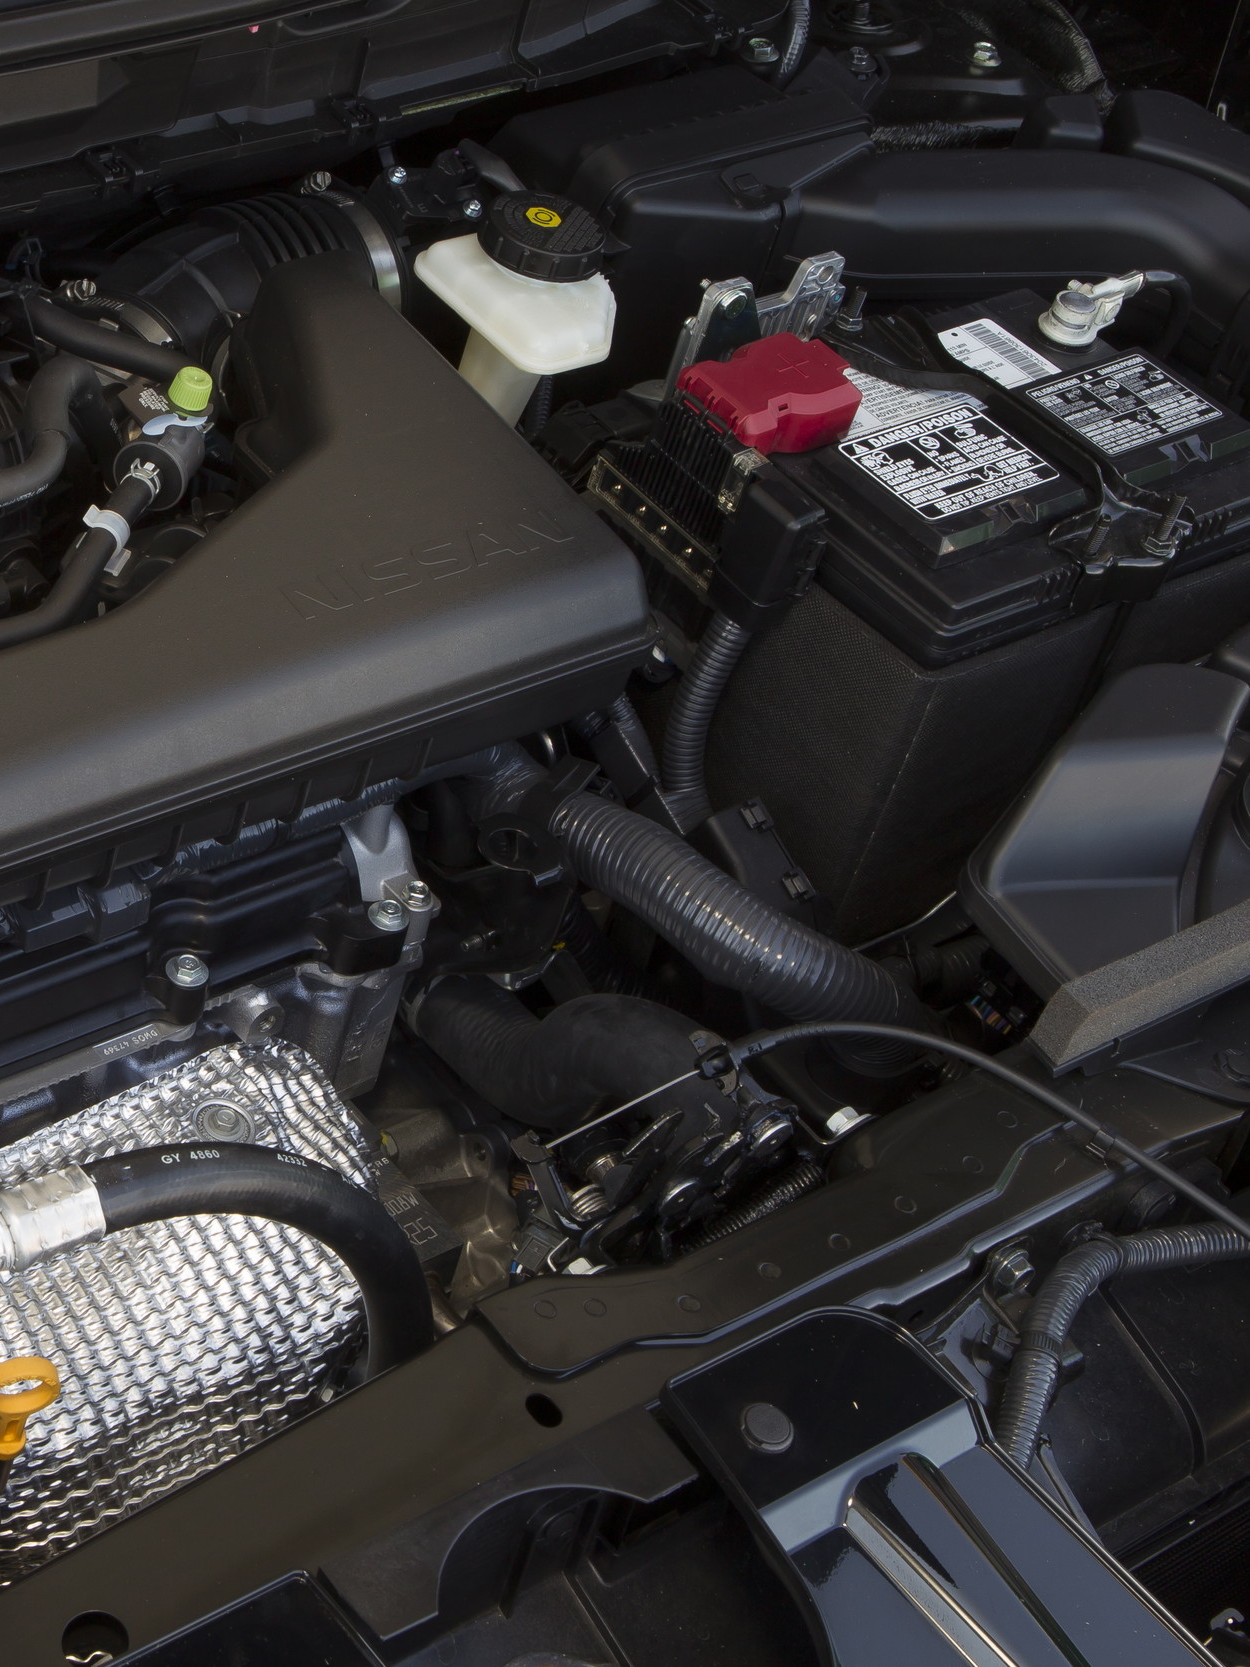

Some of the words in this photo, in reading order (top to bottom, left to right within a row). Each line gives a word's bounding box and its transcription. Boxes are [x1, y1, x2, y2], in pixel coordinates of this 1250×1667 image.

[868, 408, 974, 447] DANGER/POISON
[927, 450, 939, 458] NO
[933, 499, 952, 509] KEEP
[951, 494, 966, 503] OUT
[964, 491, 975, 499] OF
[973, 484, 998, 495] REACH
[994, 481, 1005, 489] OF
[278, 510, 574, 622] NISSAN
[160, 1152, 181, 1165] GY
[189, 1149, 220, 1161] 4860
[276, 1153, 308, 1167] 42332
